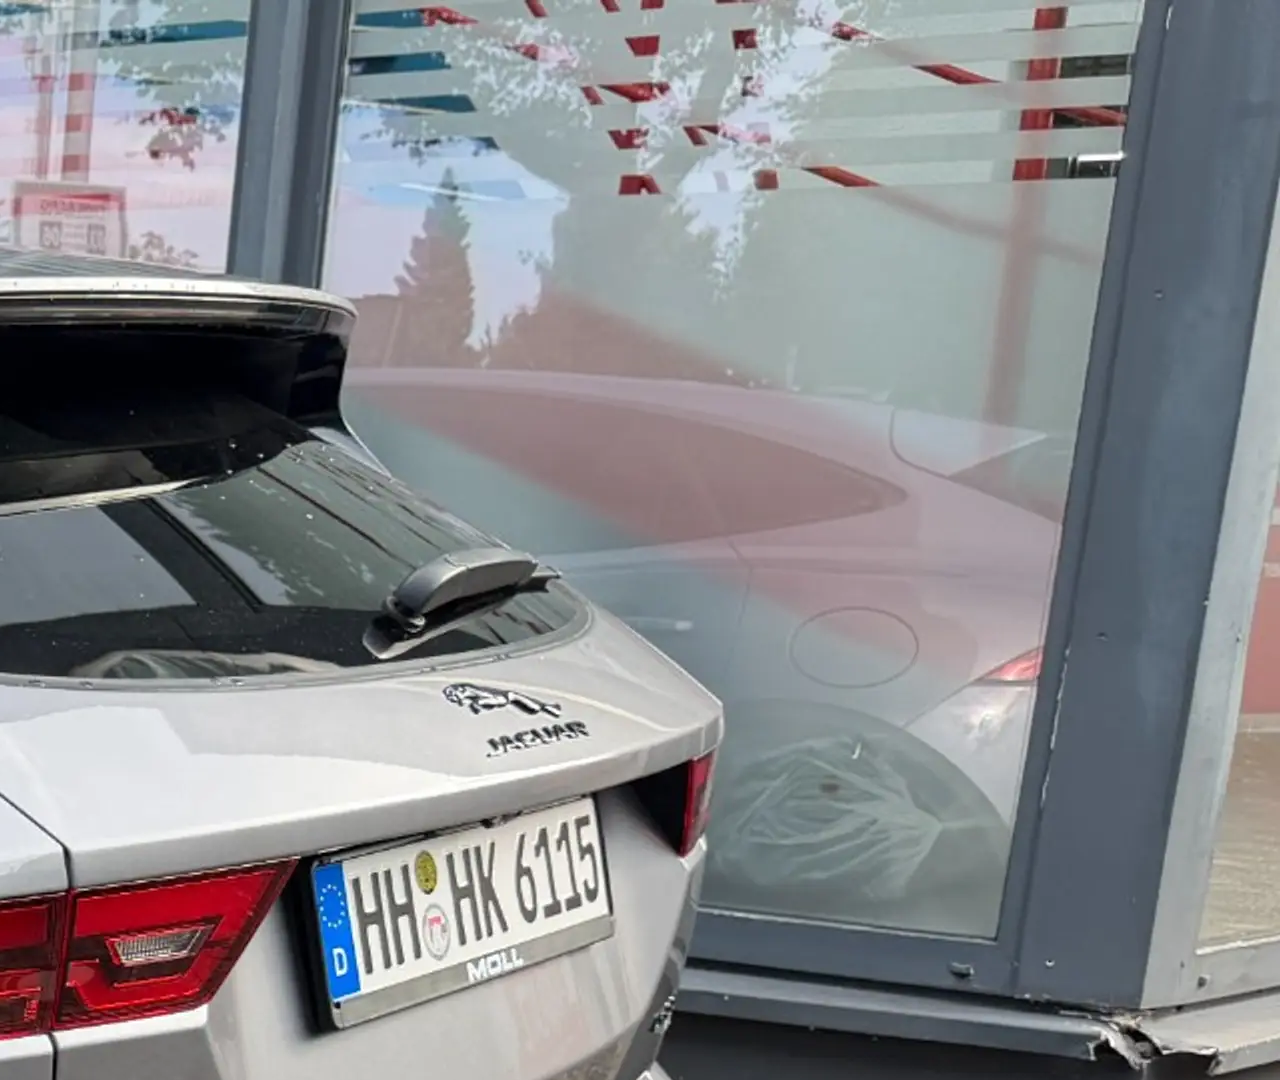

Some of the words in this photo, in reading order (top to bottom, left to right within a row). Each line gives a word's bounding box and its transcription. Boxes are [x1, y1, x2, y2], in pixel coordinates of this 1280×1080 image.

[486, 720, 591, 758] JAGUAR
[351, 863, 423, 976] HH
[446, 841, 509, 947] HK
[515, 815, 600, 924] 6115
[332, 947, 348, 978] D
[466, 947, 525, 984] MOLL
